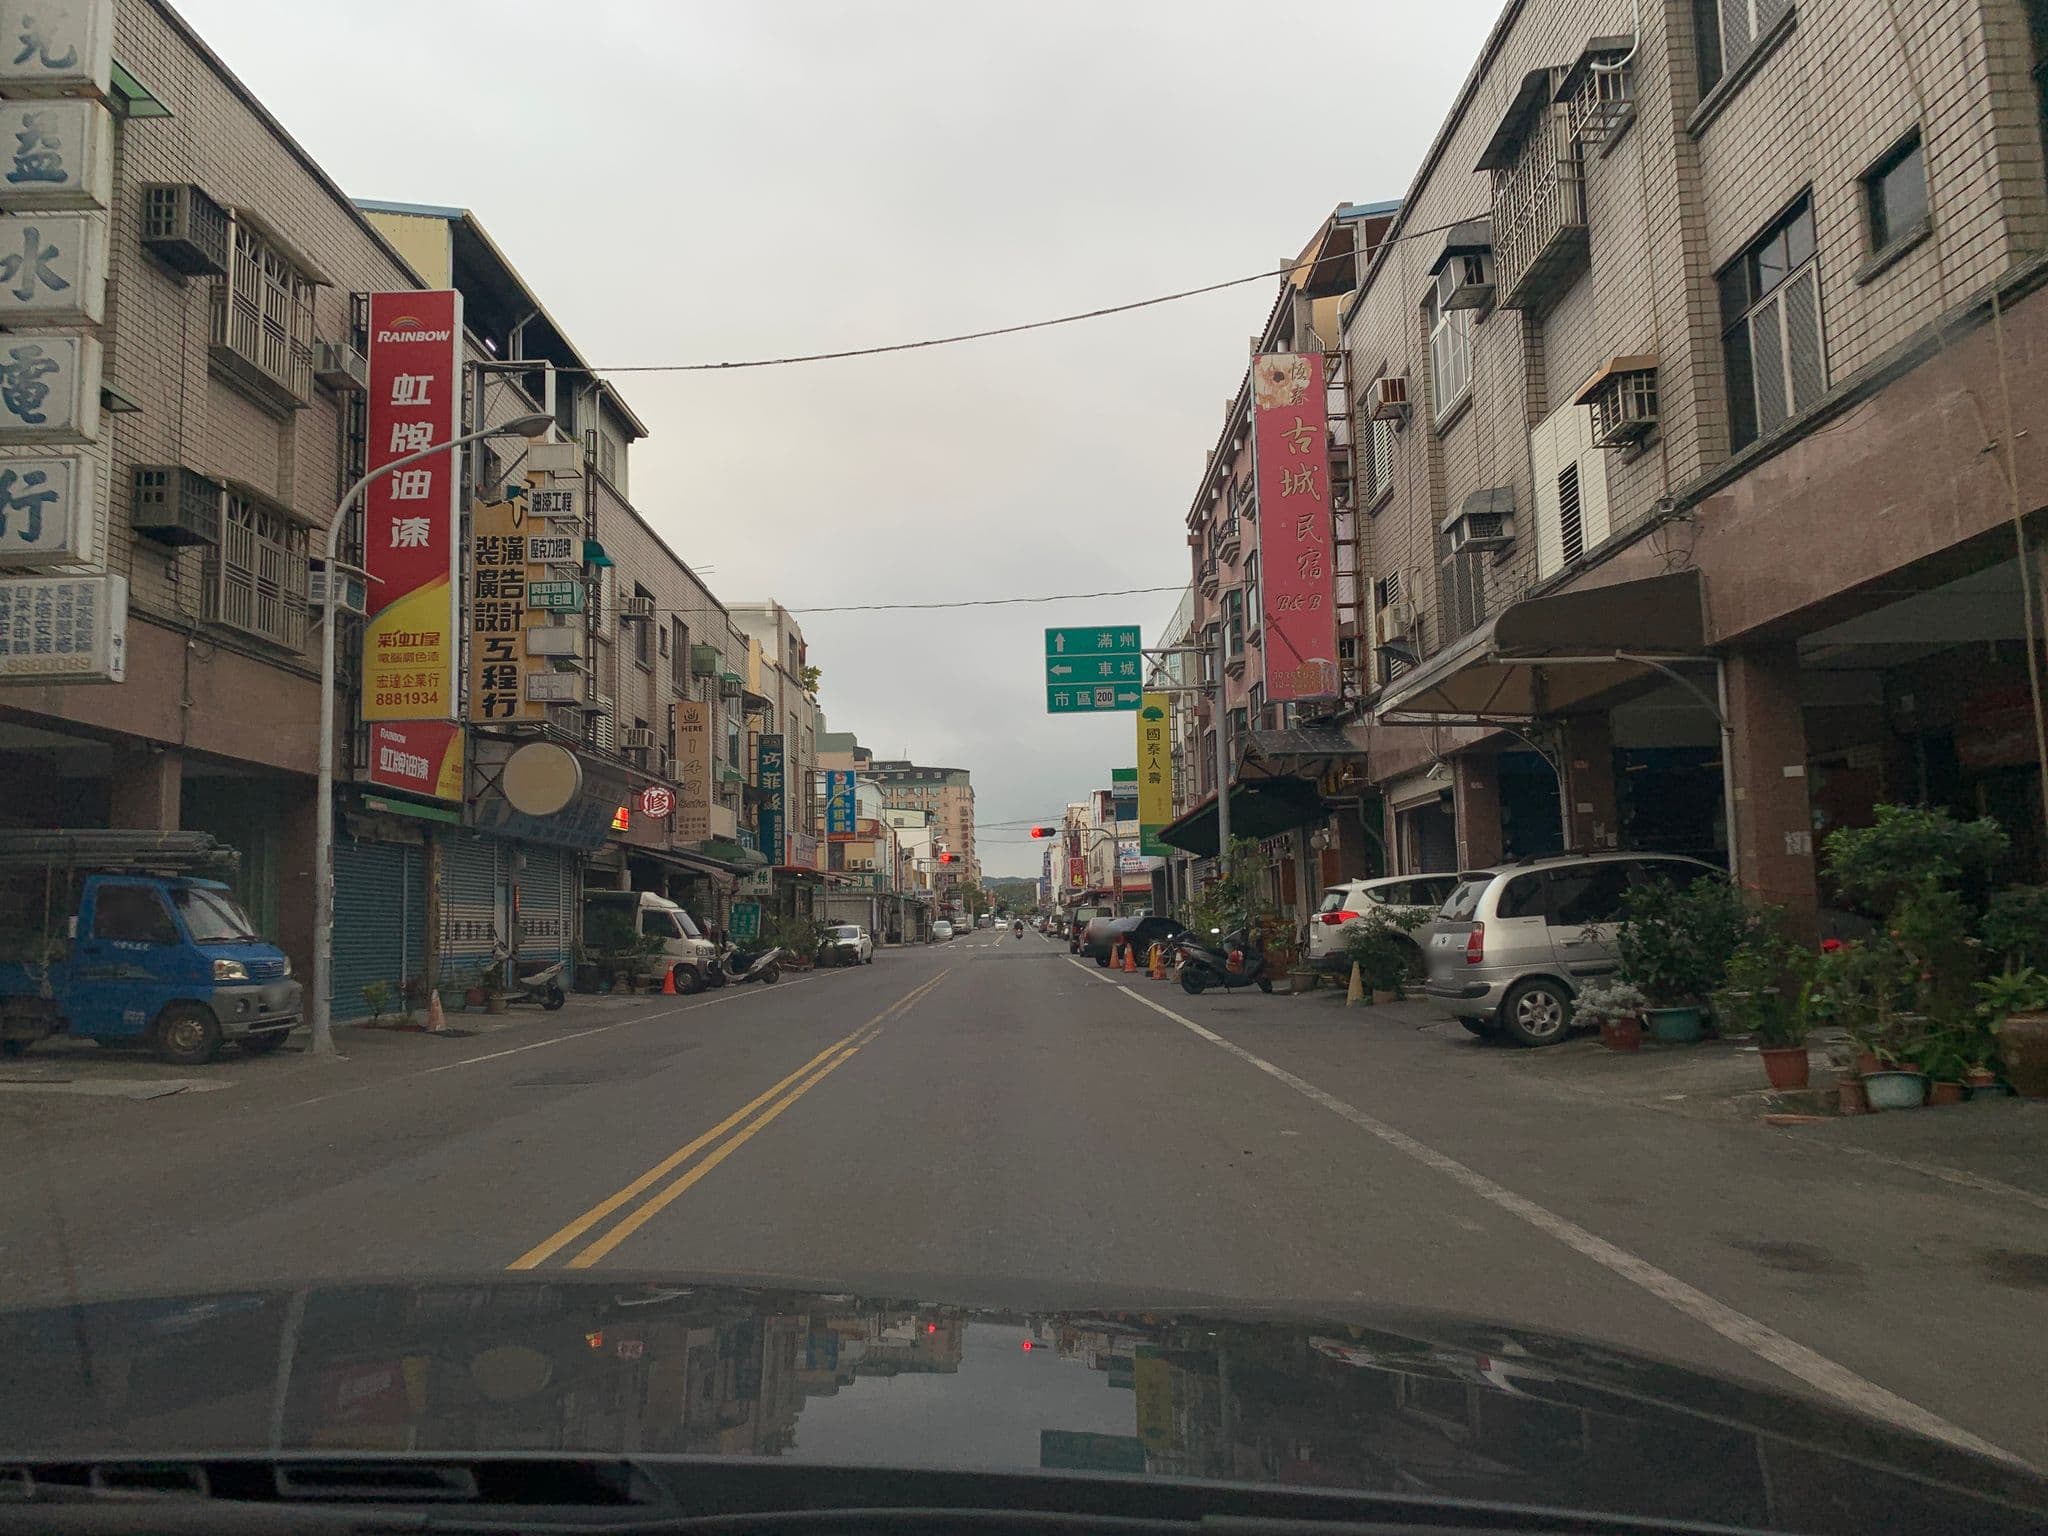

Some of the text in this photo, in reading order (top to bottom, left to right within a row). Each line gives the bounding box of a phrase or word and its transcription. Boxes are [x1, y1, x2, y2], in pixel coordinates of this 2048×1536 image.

[377, 330, 450, 343] RAINBOW
[390, 373, 434, 548] 虹牌油漆
[531, 488, 572, 512] 油漆工程
[531, 538, 571, 561] 壓克力招牌
[377, 630, 440, 648] 彩虹屋
[1097, 632, 1135, 648] 滿州
[1098, 661, 1136, 676] 車城
[376, 691, 438, 706] 8881934
[1054, 691, 1112, 707] 市區 200
[379, 746, 429, 780] 虹牌油漆
[1146, 728, 1161, 784] 國泰人壽
